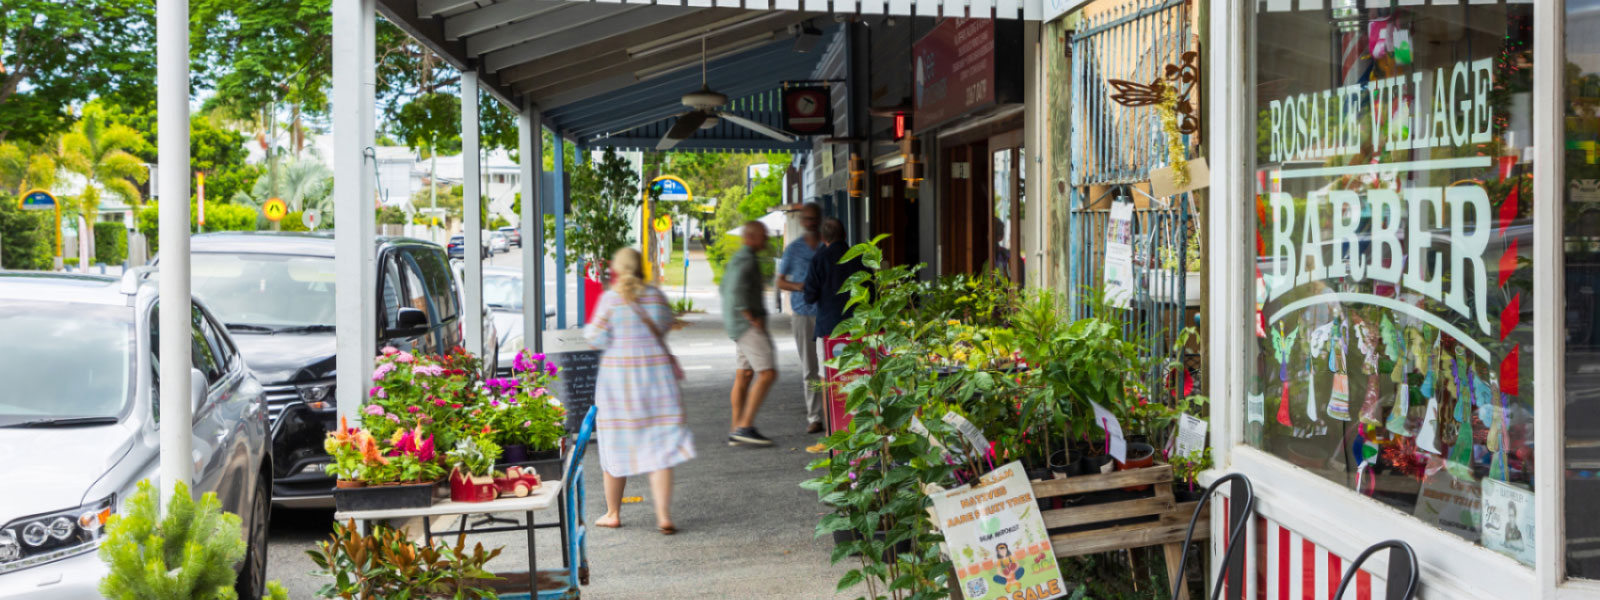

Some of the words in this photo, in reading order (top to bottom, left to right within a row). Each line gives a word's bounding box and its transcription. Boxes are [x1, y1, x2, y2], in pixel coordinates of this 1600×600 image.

[1270, 84, 1361, 162] ROSALIE
[1368, 57, 1493, 153] VILLAGE
[1269, 186, 1492, 336] BARBER
[1012, 579, 1062, 600] SALE
